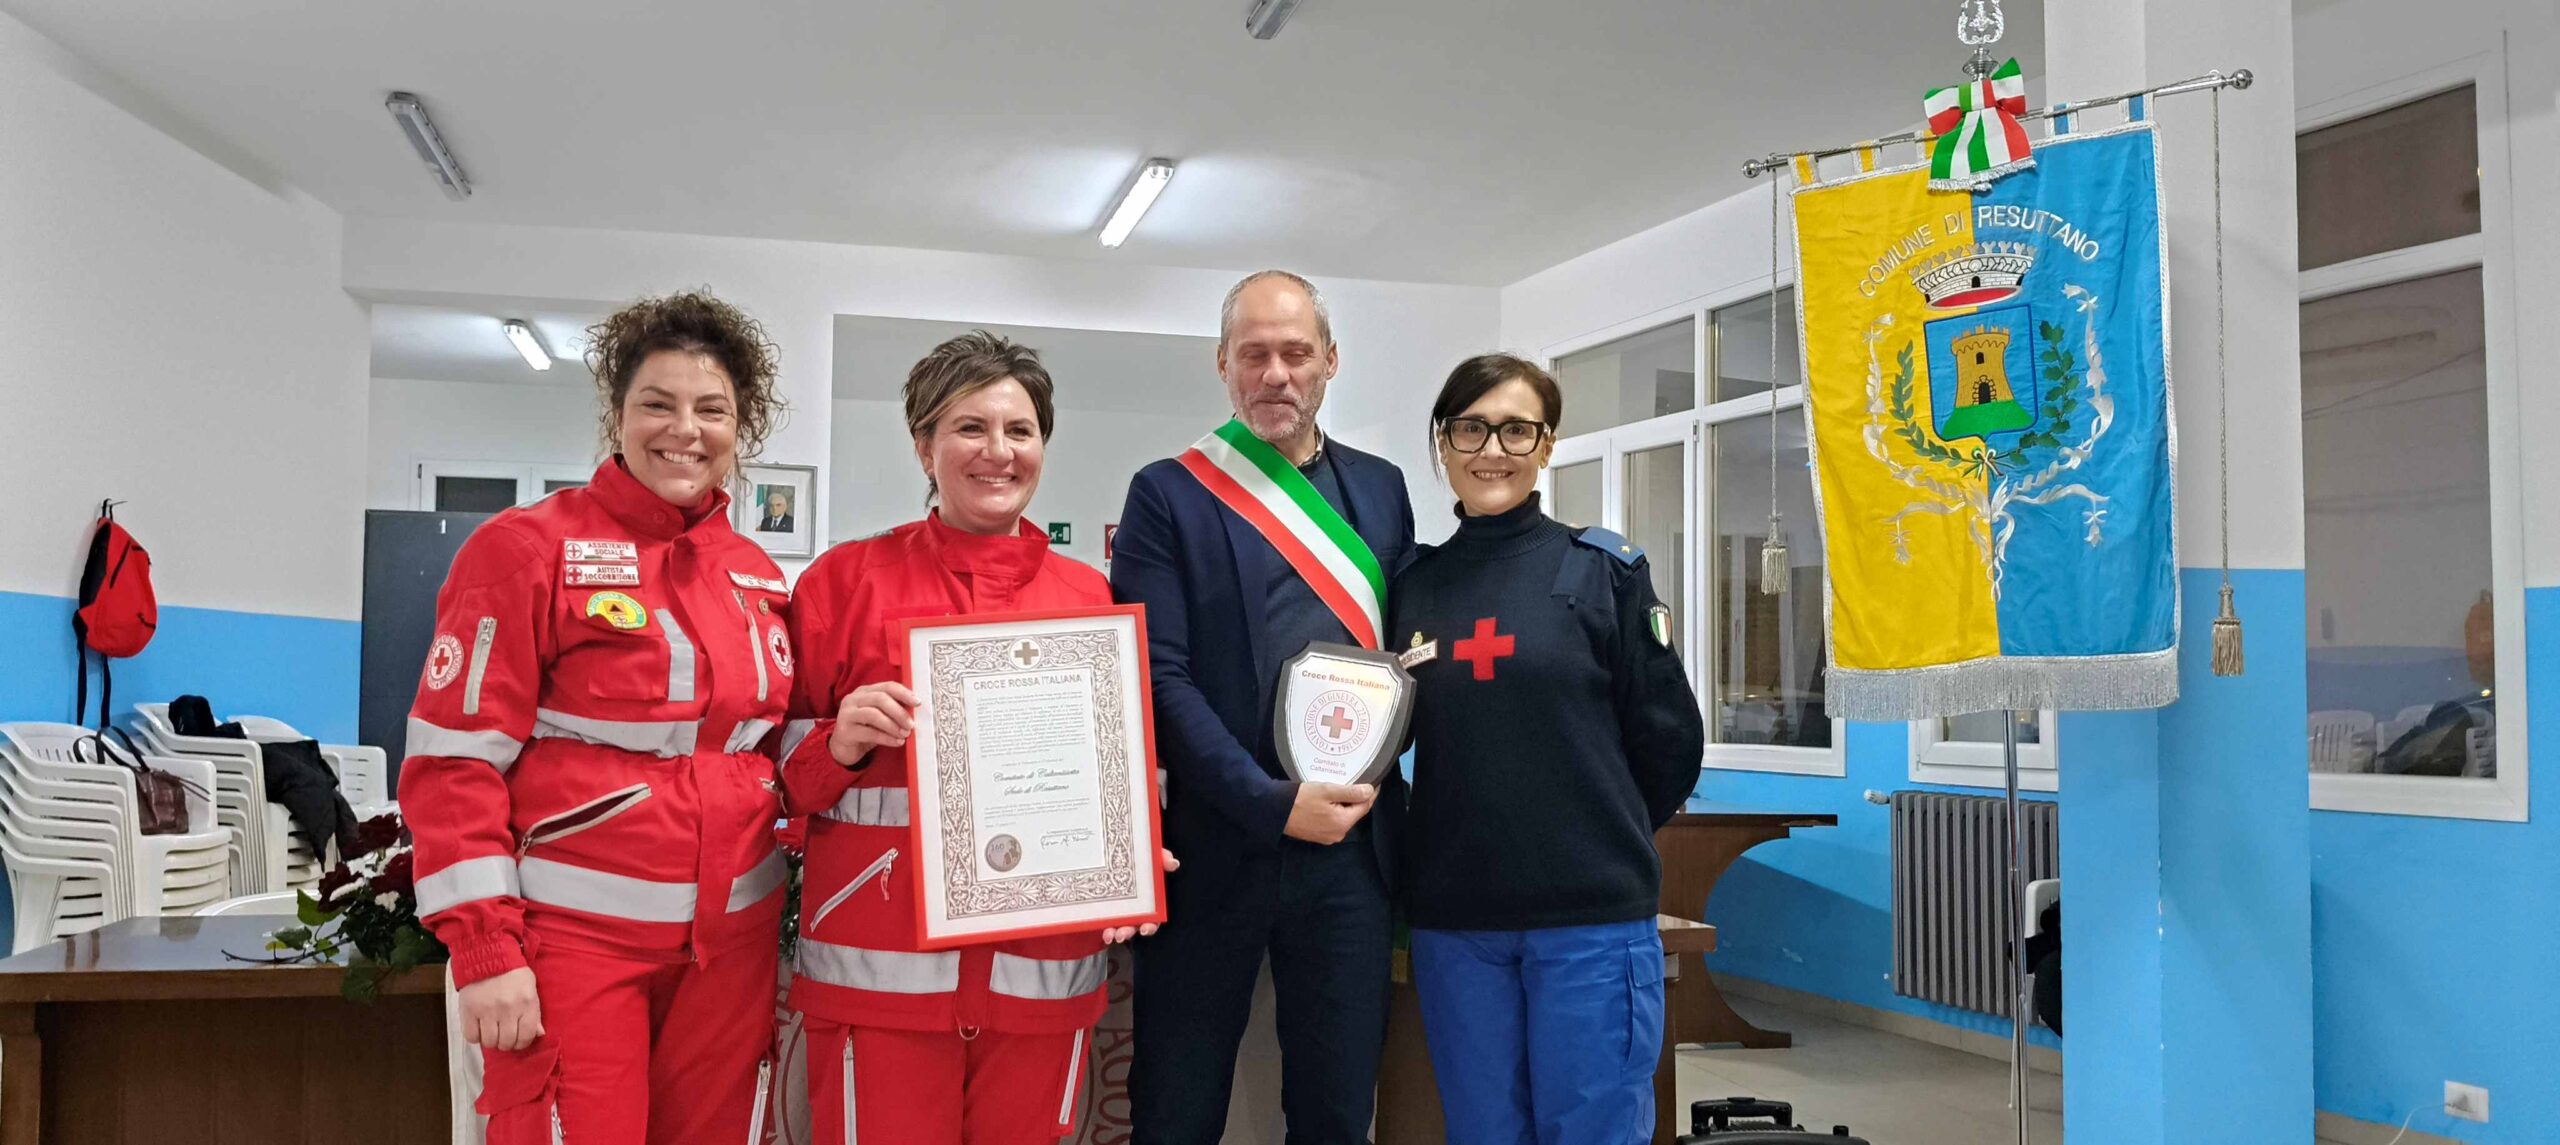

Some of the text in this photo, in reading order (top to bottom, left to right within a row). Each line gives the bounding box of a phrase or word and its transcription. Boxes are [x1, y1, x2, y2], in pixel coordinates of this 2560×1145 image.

[1858, 204, 2100, 299] COMUNE DI RESUTTANO
[587, 542, 630, 550] ASSISTENTE
[594, 548, 625, 556] SOCIALE
[597, 566, 625, 574] AUTISTA
[973, 674, 1083, 691] CROCE ROSSA ITALIANA
[1301, 670, 1391, 690] Croce Rossa Italiana
